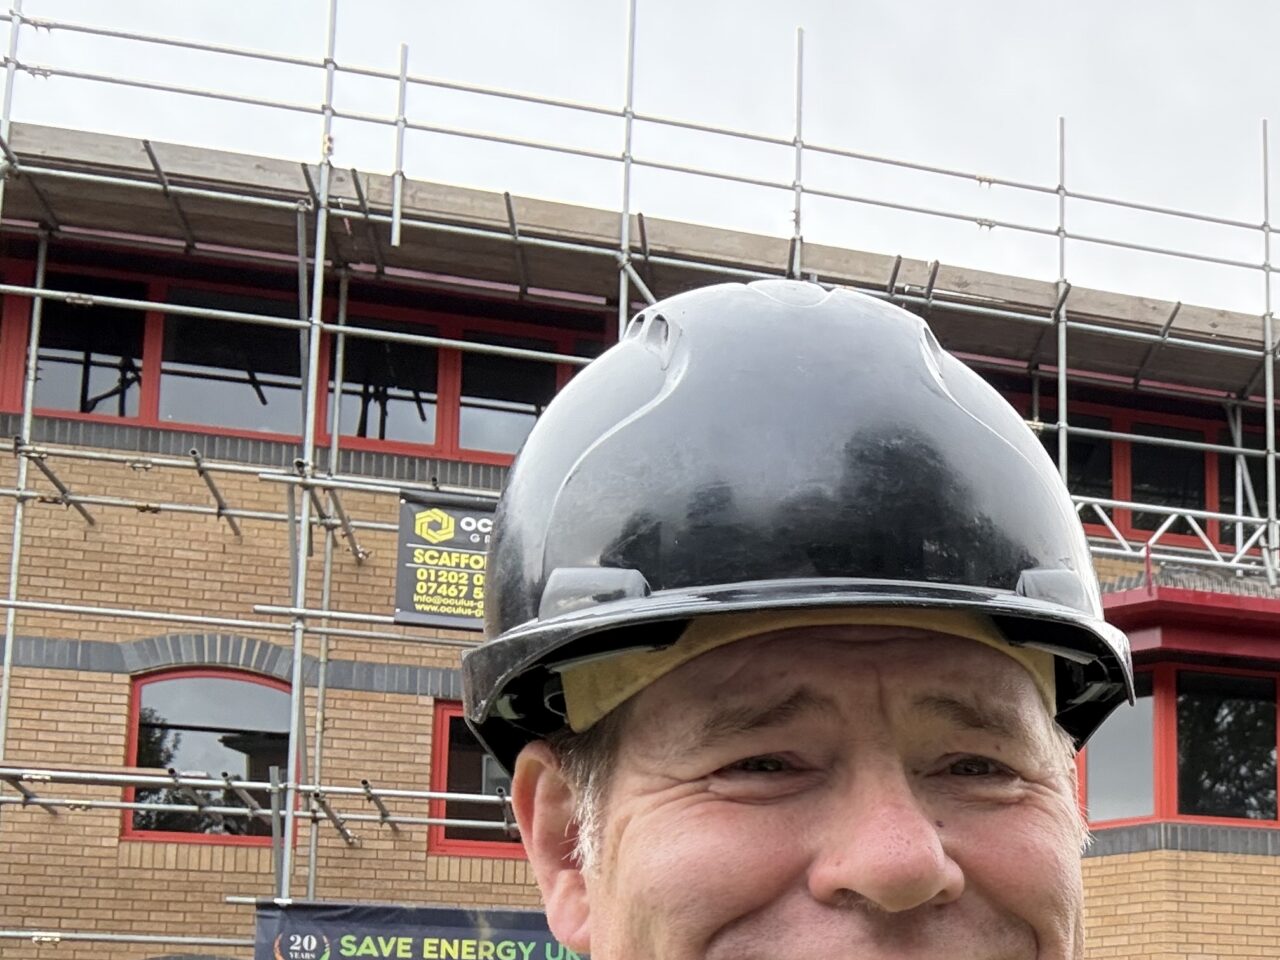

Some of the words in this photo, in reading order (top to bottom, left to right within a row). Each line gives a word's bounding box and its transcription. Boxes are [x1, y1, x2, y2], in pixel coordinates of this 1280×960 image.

[416, 568, 469, 585] 01202
[415, 581, 469, 598] 07467
[288, 934, 318, 951] 20
[339, 934, 413, 958] SAVE
[288, 950, 317, 960] YEARS
